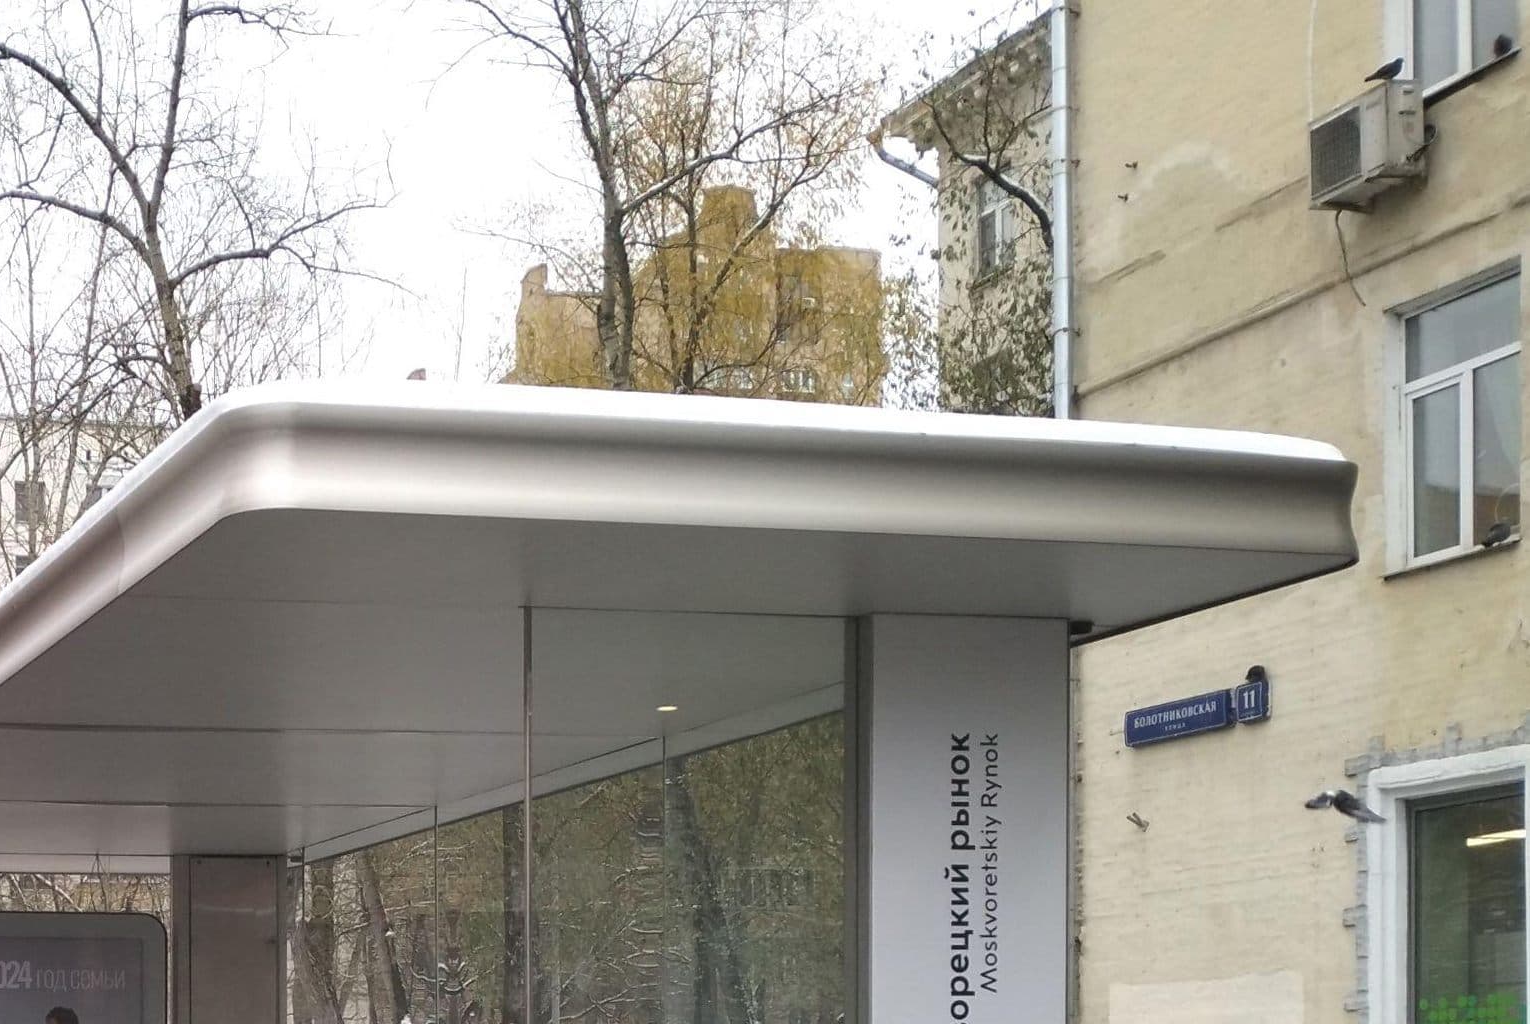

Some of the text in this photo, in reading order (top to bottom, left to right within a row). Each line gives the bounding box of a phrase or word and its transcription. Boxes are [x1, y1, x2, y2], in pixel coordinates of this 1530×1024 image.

[1243, 689, 1256, 709] 11
[1133, 700, 1217, 729] БОЛОТНИКОВСКАЯ
[950, 732, 976, 850] рынок
[980, 732, 1002, 994] Moskvoretskiy Rynok
[36, 968, 68, 992] ГОД
[70, 968, 126, 990] СЕМЬИ
